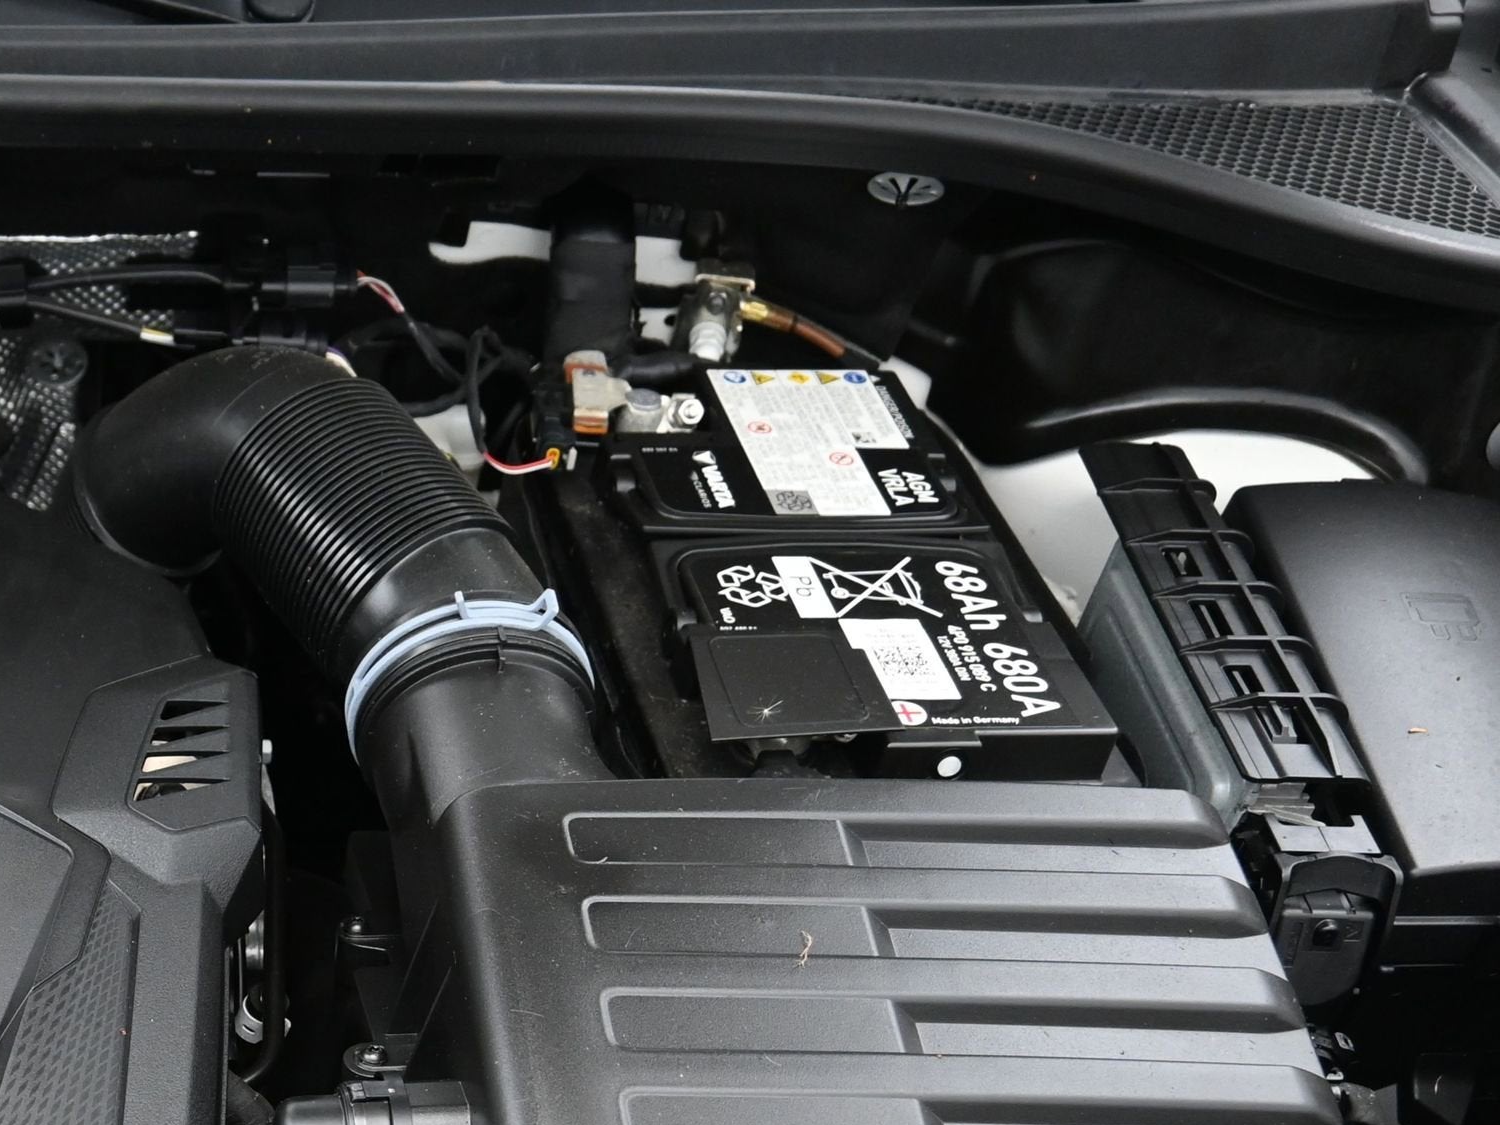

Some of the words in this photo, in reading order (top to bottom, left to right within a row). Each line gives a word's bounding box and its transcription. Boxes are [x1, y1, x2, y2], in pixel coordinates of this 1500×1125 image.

[693, 480, 712, 509] CLARIOS
[701, 465, 735, 509] VARTA
[878, 468, 915, 506] VRLA
[902, 471, 939, 504] AGM
[789, 576, 812, 597] Pb
[935, 561, 1007, 630] 68Ah
[983, 641, 1062, 718] 680A
[958, 645, 981, 662] 915
[980, 683, 997, 692] C
[931, 716, 960, 725] Made
[973, 716, 1020, 726] Germany
